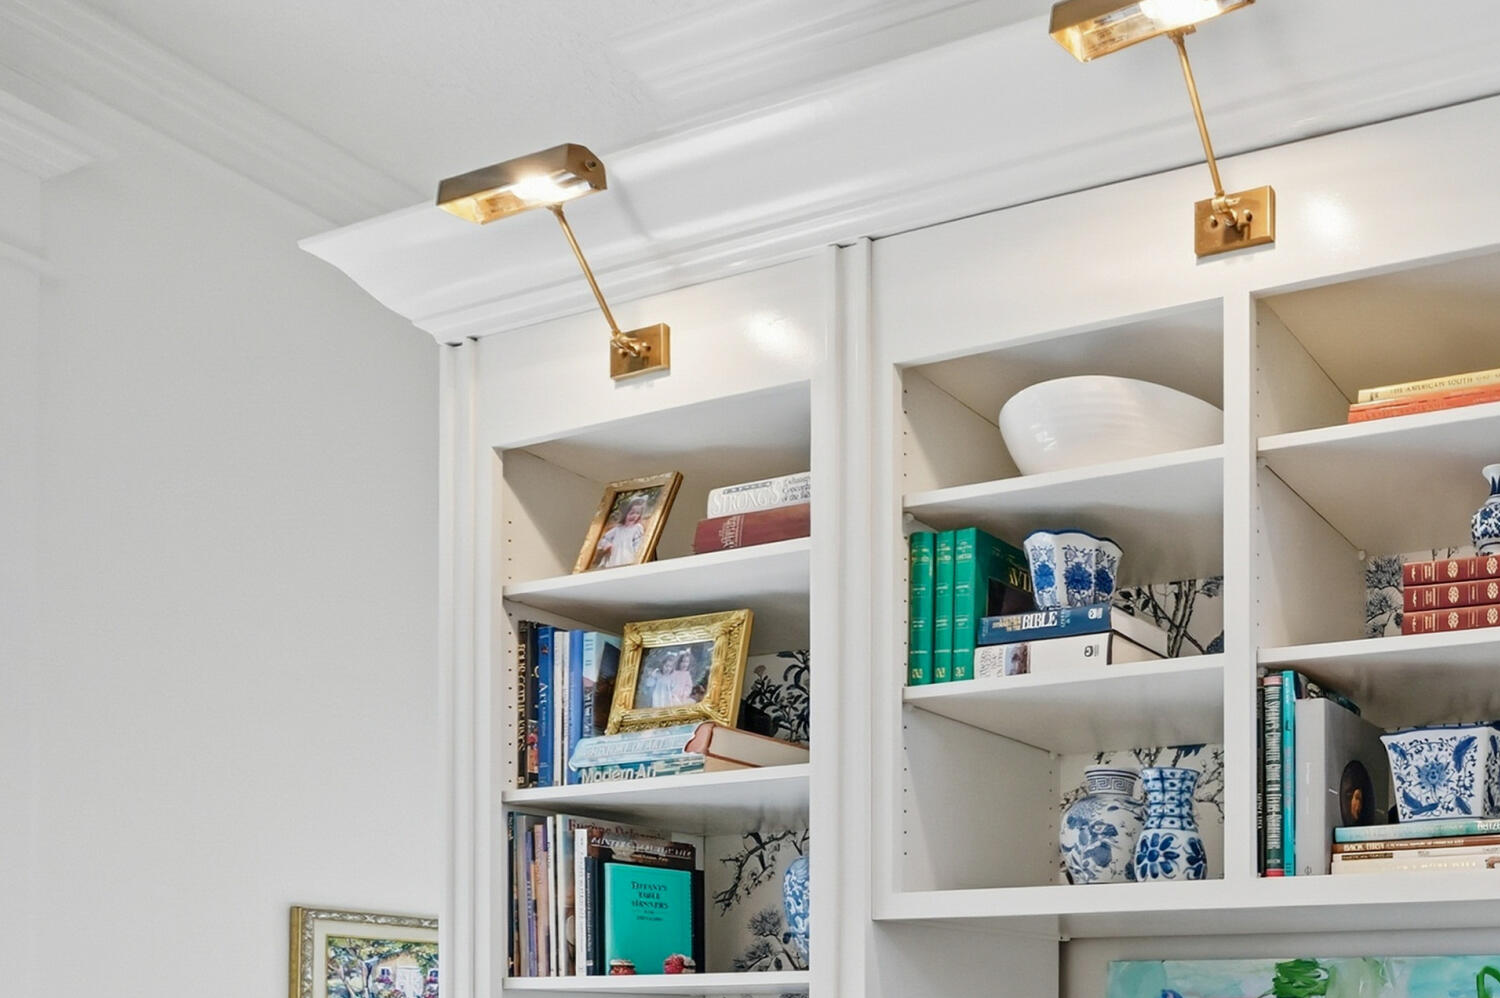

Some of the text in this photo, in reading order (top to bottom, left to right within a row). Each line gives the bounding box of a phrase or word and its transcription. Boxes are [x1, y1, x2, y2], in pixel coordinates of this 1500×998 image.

[1022, 611, 1058, 630] BIBLE
[539, 682, 548, 705] Art
[581, 766, 634, 784] Modern
